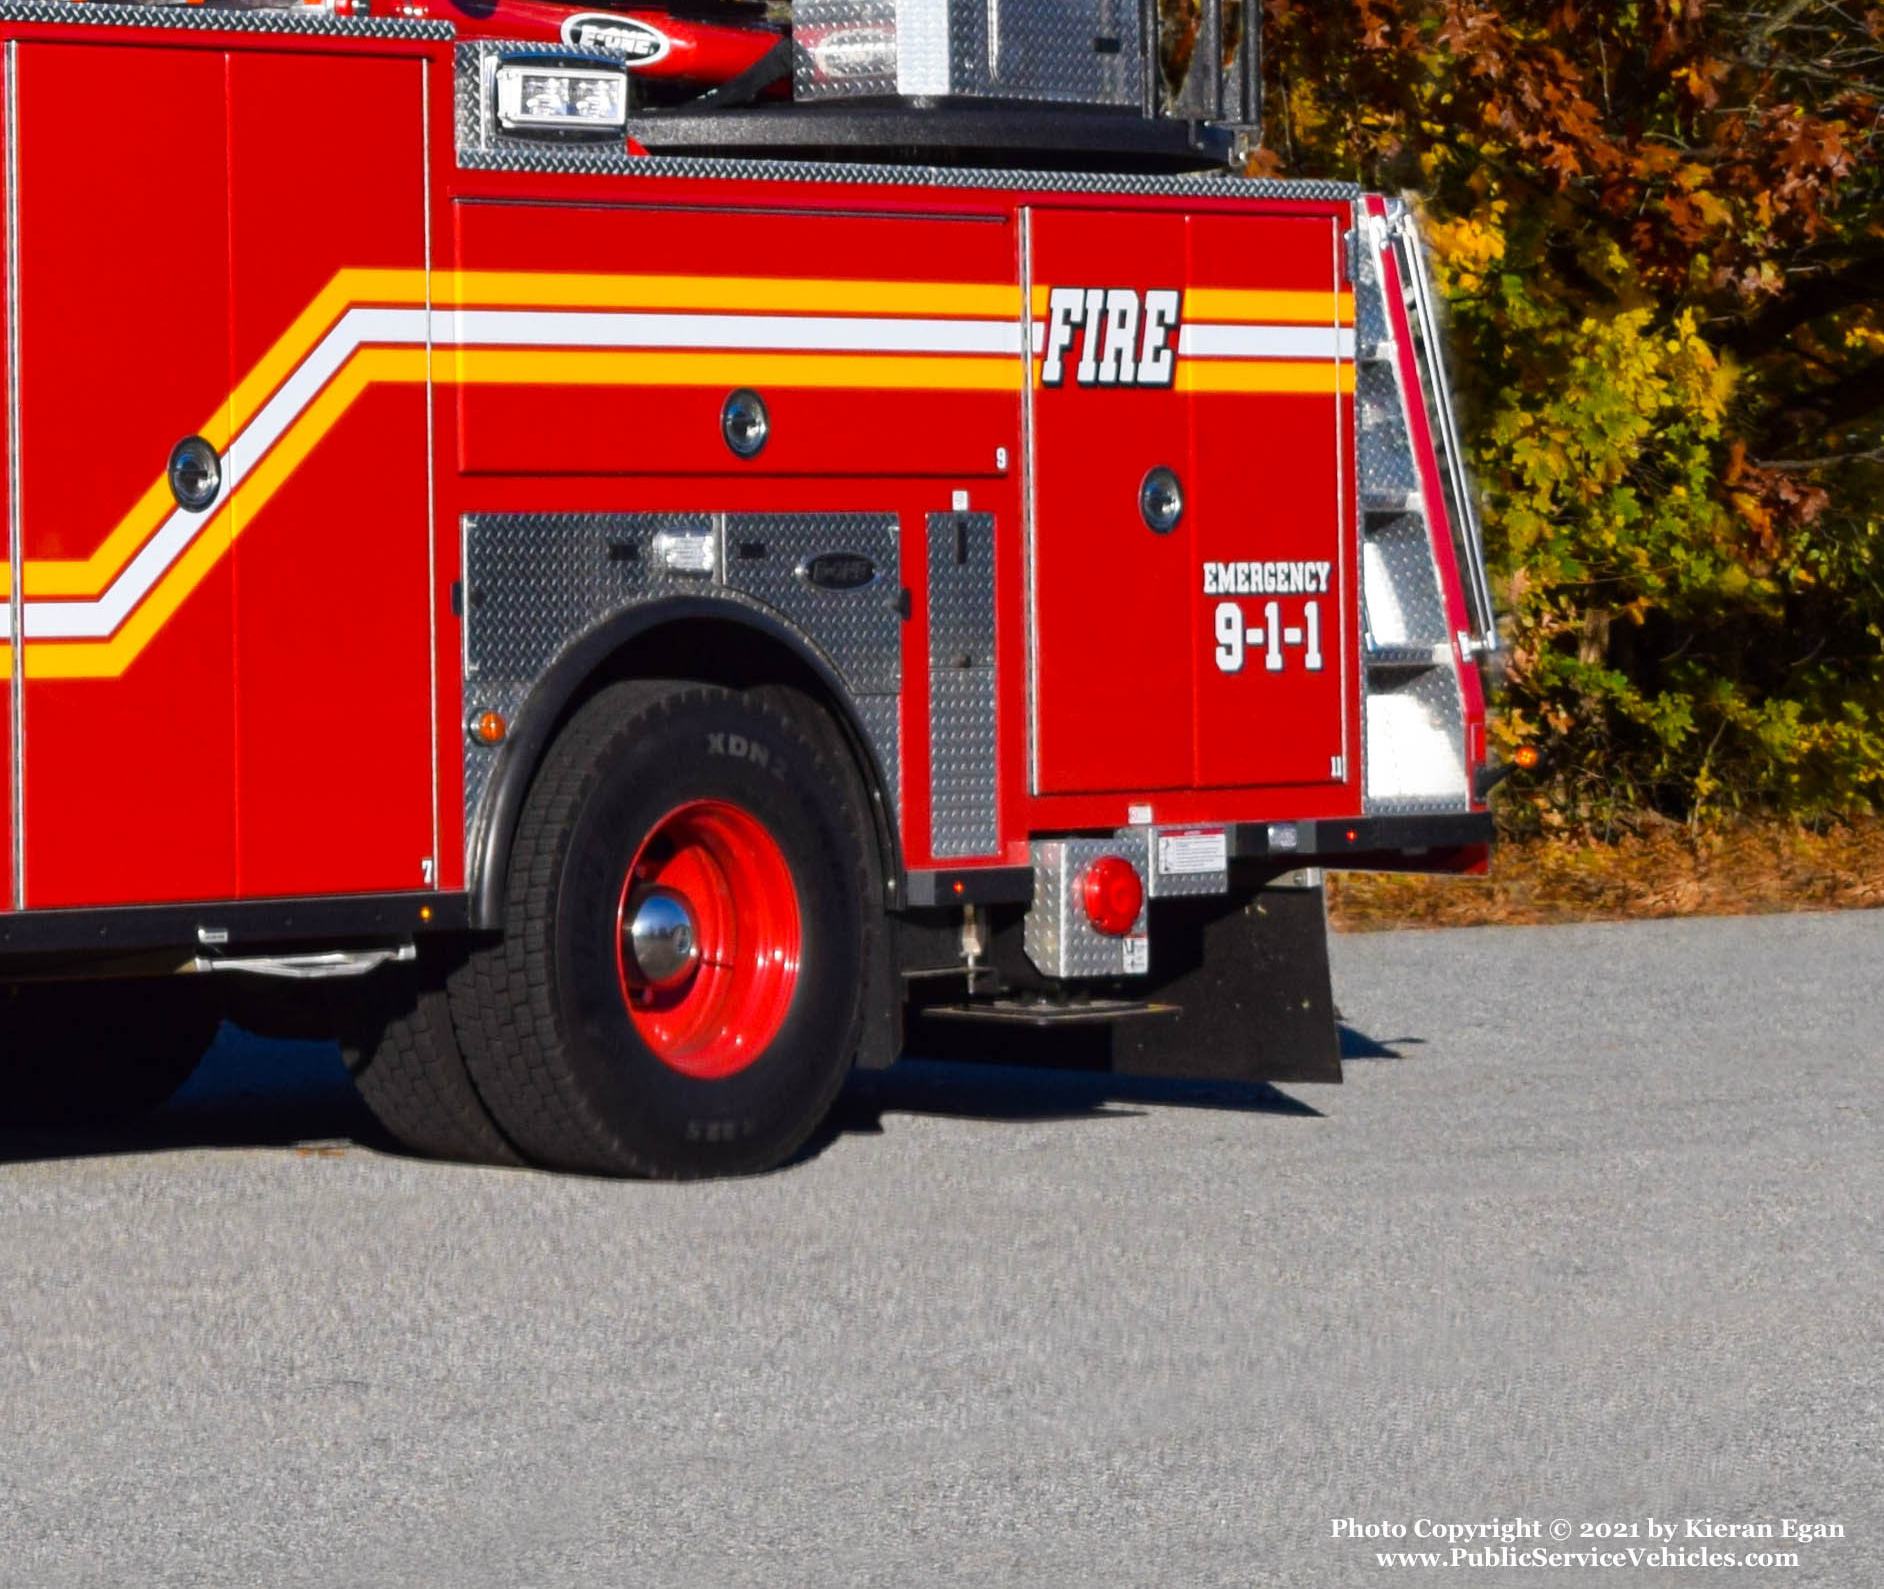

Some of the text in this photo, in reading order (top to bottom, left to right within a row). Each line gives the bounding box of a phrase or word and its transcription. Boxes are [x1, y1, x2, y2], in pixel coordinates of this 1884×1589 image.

[579, 24, 657, 55] E-ONE
[1041, 287, 1182, 389] FIRE
[995, 446, 1007, 470] 9
[1202, 560, 1331, 595] EMERGENCY
[1214, 600, 1324, 673] 9-1-1
[421, 857, 434, 886] 7
